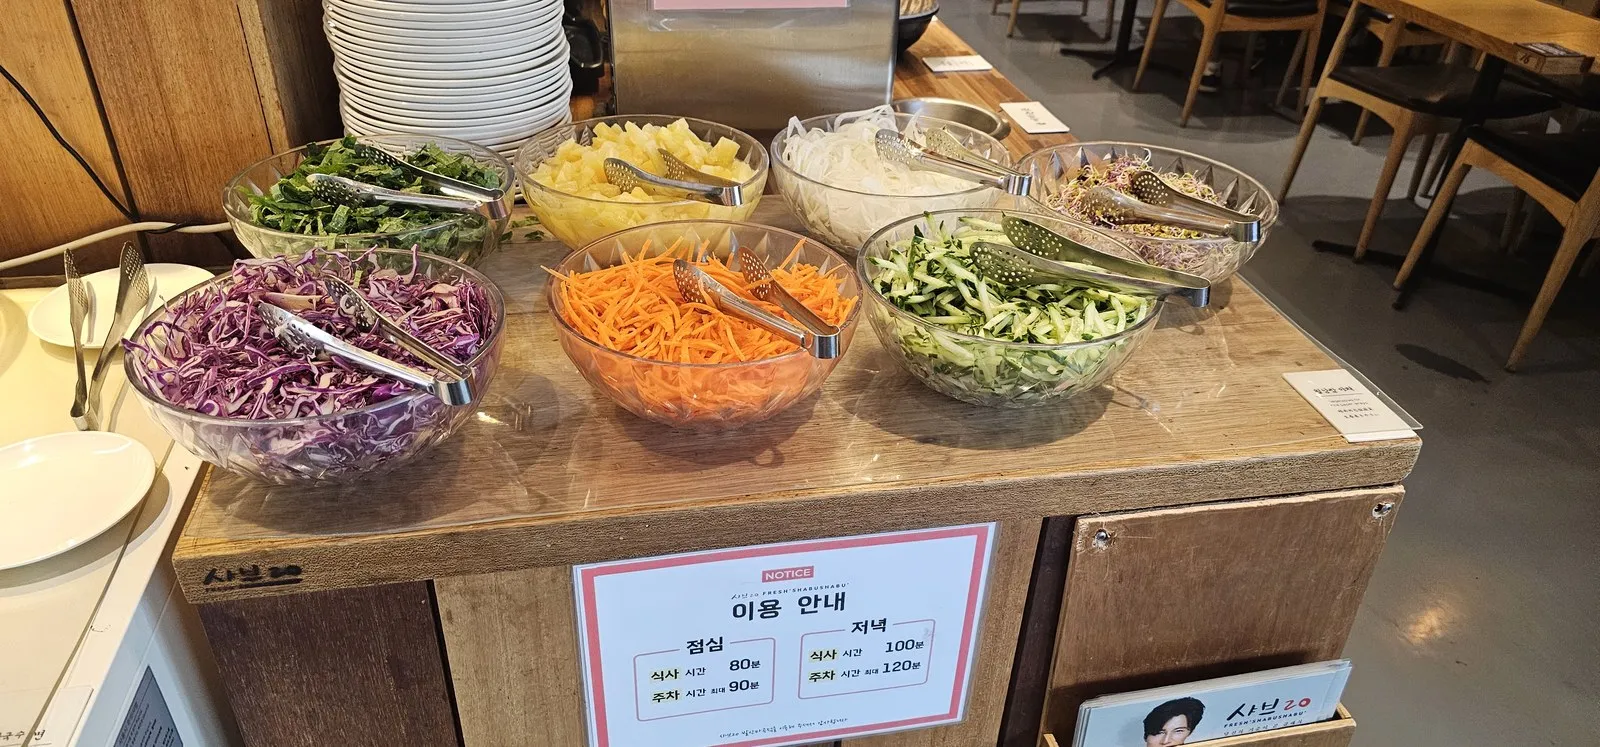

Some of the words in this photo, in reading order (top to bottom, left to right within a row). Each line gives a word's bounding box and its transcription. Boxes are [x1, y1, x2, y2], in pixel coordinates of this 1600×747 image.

[765, 568, 811, 580] NOTICE
[732, 599, 782, 621] 이용
[797, 592, 846, 615] 안내
[851, 618, 887, 635] 저녁
[686, 636, 723, 655] 점심
[810, 649, 837, 661] 식사
[842, 648, 863, 658] 시간
[885, 639, 924, 653] 100분
[651, 669, 679, 681] 식사
[685, 667, 706, 677] 시간
[729, 658, 761, 671] 80분
[809, 670, 835, 682] 주차
[841, 669, 861, 678] 시간
[882, 660, 921, 674] 120분
[652, 690, 680, 703] 주차
[685, 688, 706, 698] 시간
[711, 687, 726, 695] 최대
[729, 679, 759, 692] 90분
